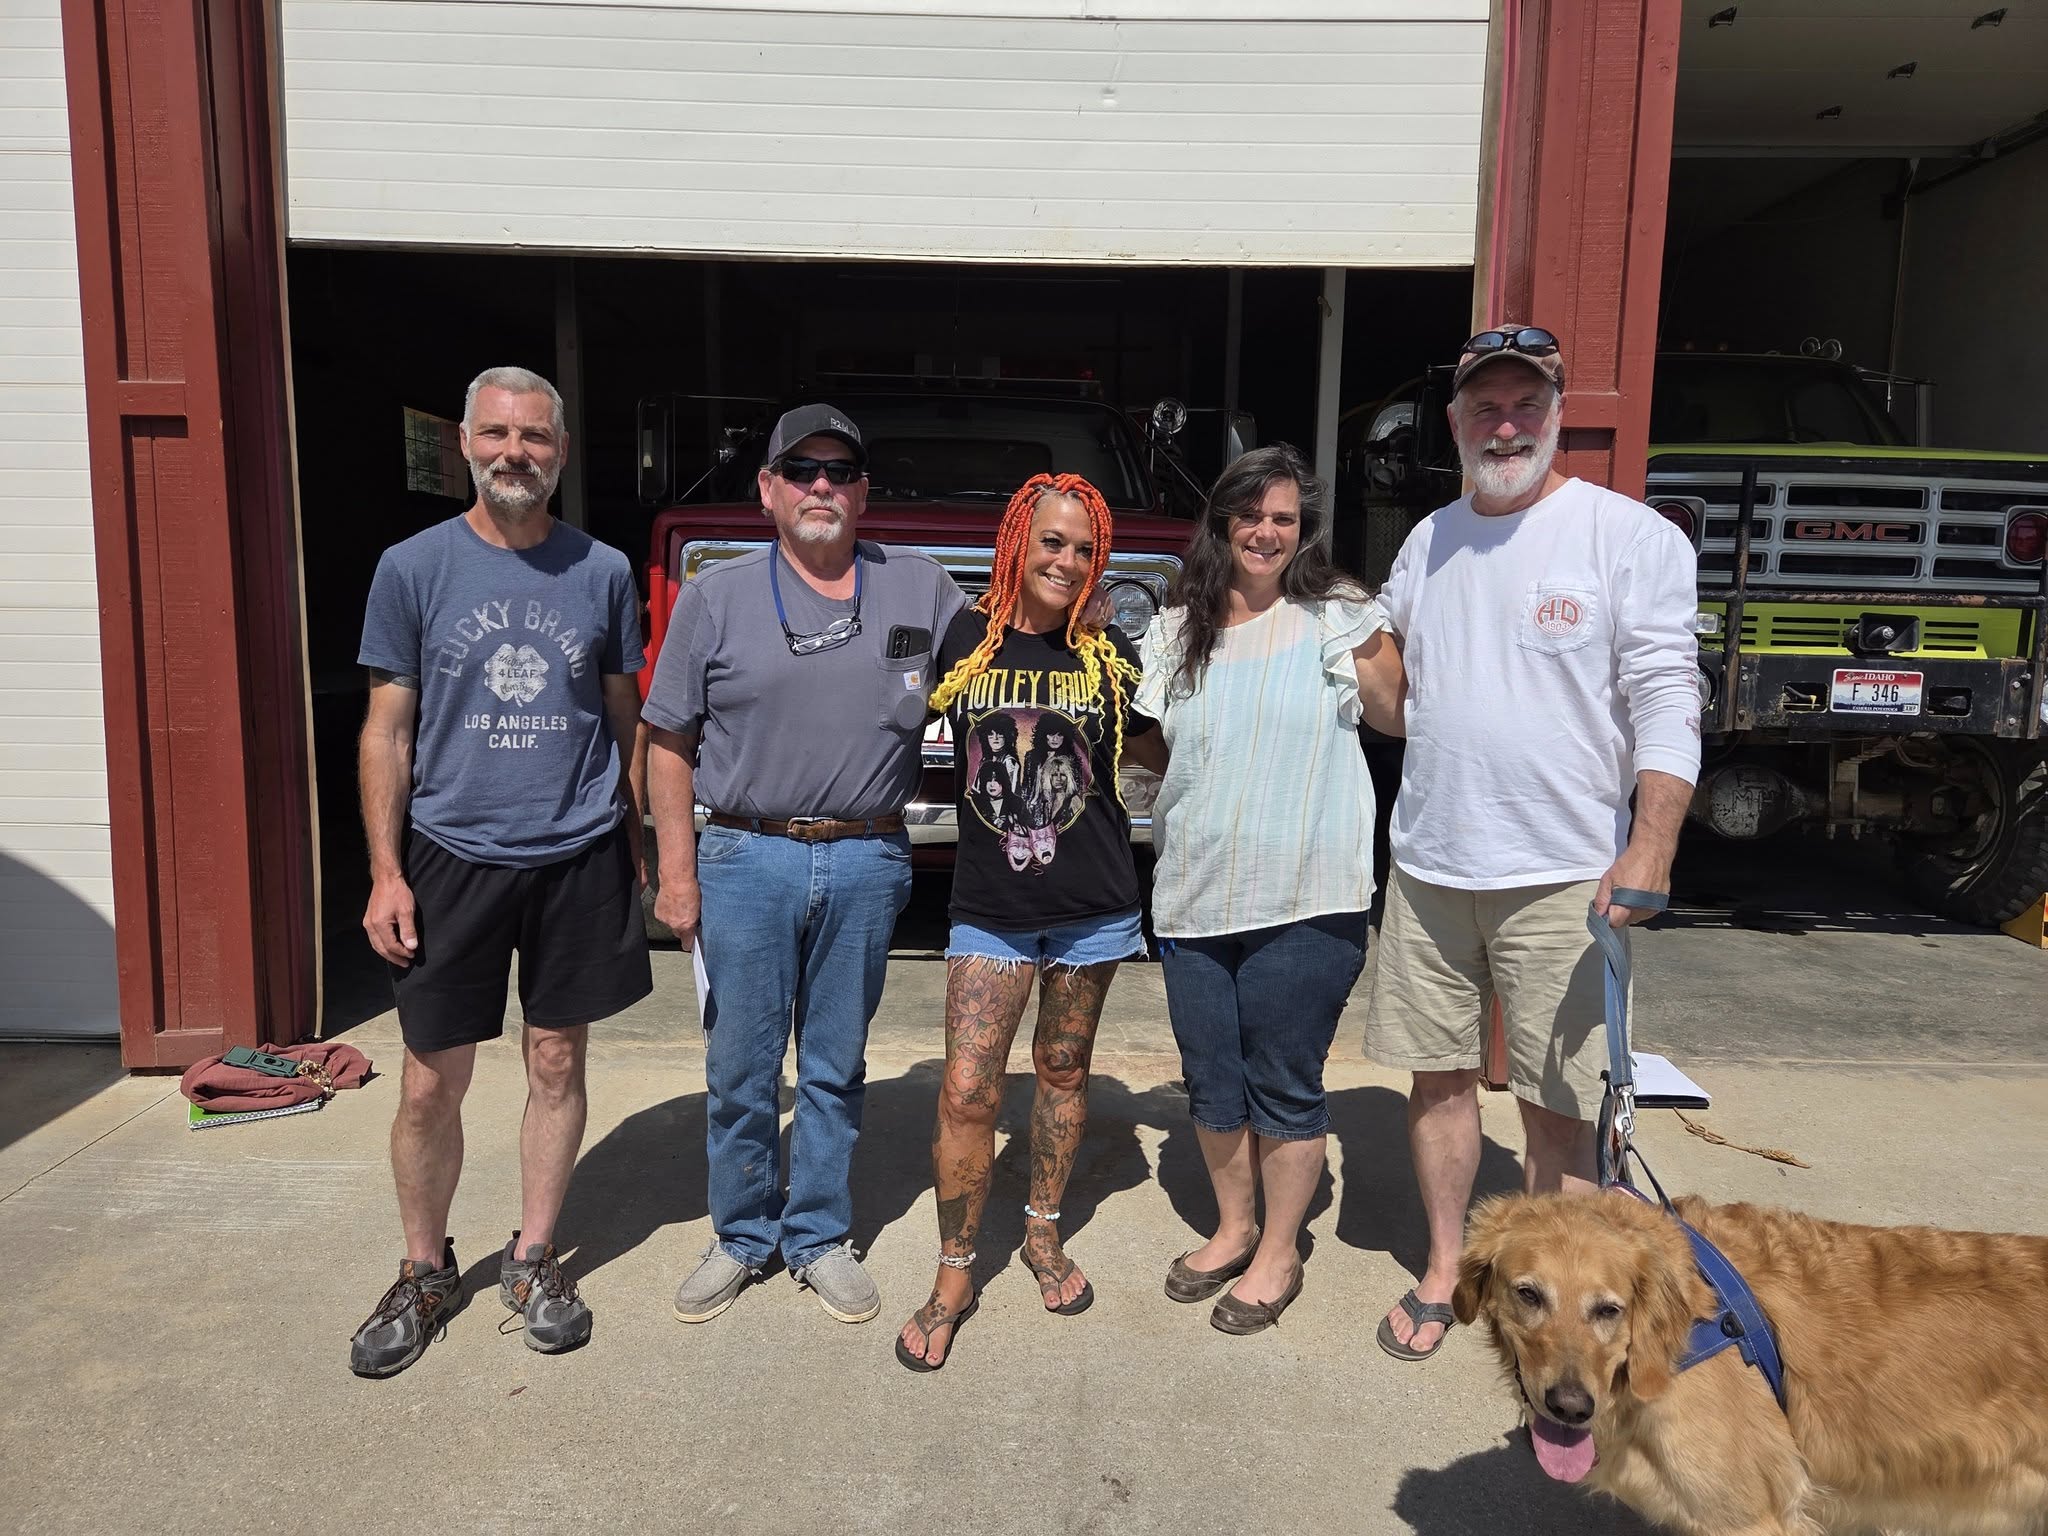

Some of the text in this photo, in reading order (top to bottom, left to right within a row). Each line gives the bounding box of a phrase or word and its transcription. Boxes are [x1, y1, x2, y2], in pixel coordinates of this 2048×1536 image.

[1795, 520, 1911, 541] GMC
[1547, 621, 1567, 631] 1903
[440, 599, 588, 679] LUCKY BRAND
[498, 669, 538, 679] 4 LEAF
[1864, 673, 1896, 682] IDAHO
[1852, 682, 1900, 703] F 346
[464, 714, 568, 731] LOS ANGELES
[488, 734, 539, 749] CALIF.
